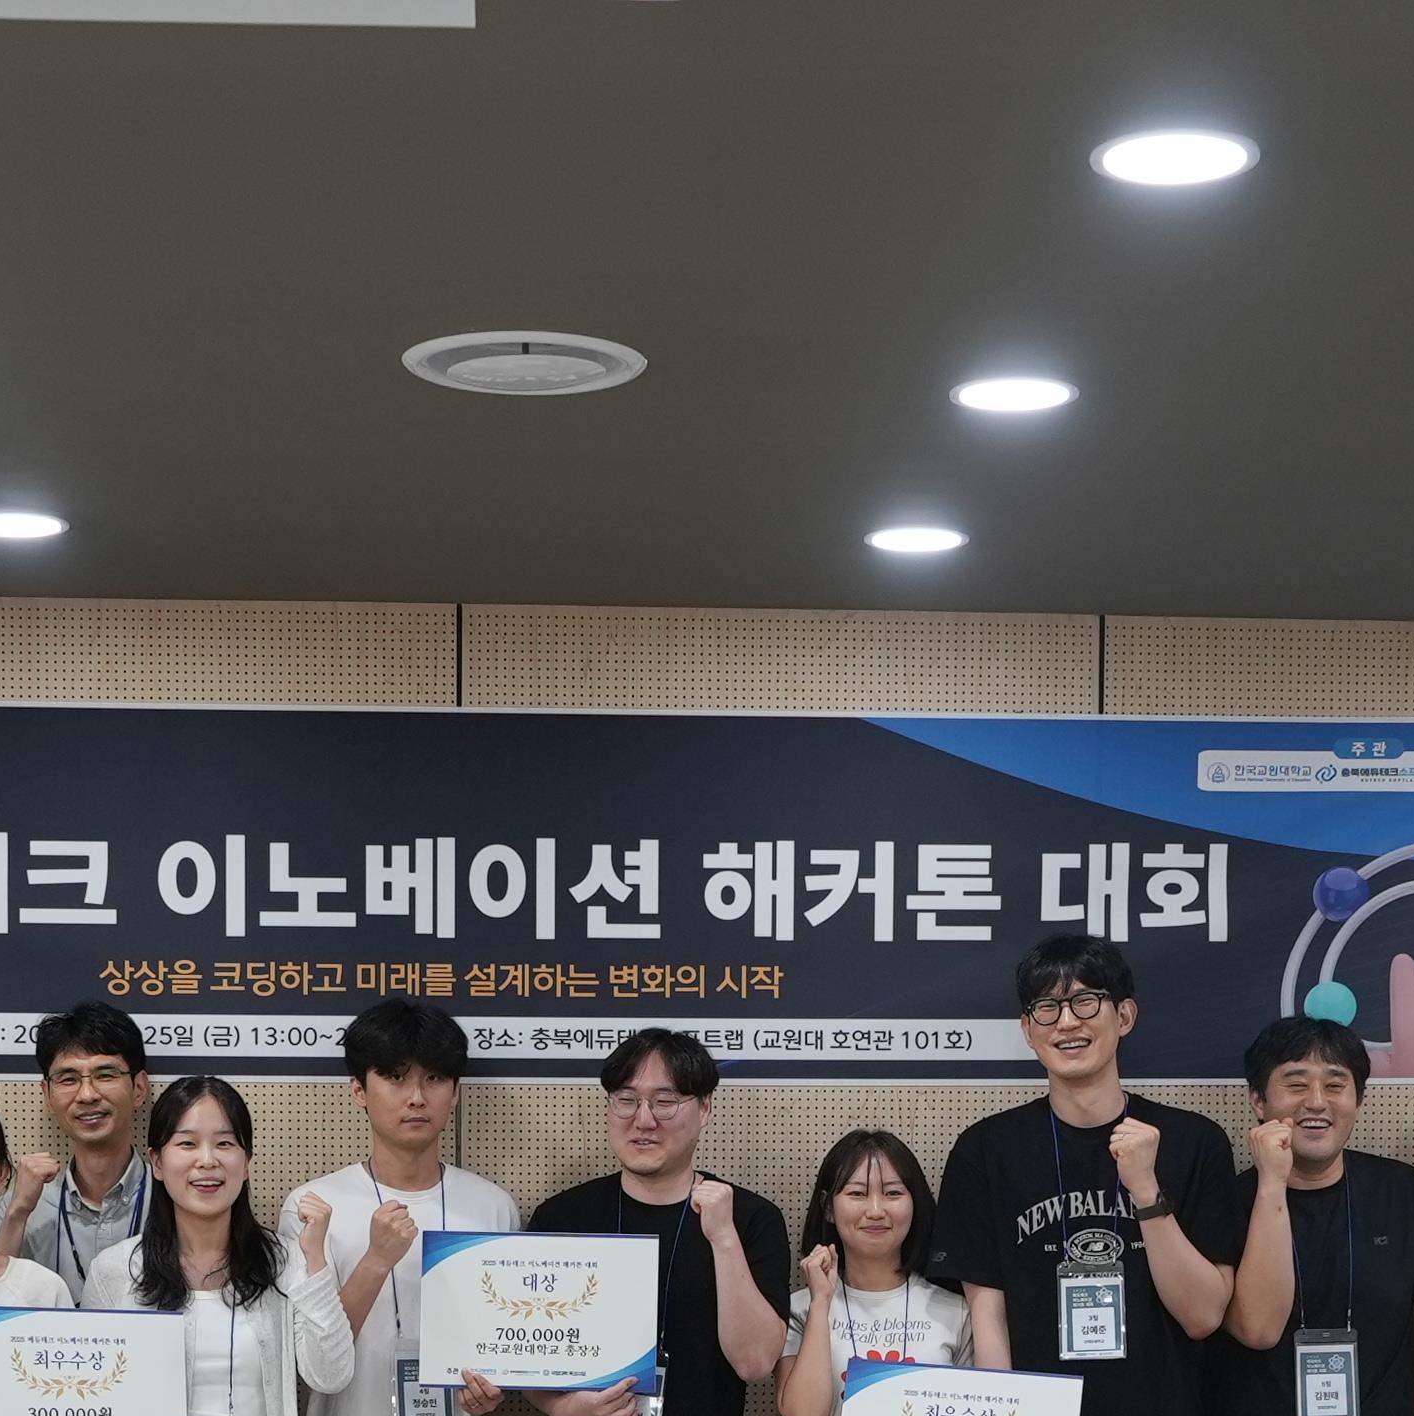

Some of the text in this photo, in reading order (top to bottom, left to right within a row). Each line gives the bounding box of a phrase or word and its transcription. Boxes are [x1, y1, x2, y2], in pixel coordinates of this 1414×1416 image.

[157, 834, 661, 940] 이노베이션
[702, 840, 1002, 943] 해커톤
[1040, 841, 1228, 943] 대회
[99, 958, 785, 999] 상상을 코딩하고 미래를 설계하는 변화의 시작
[203, 1024, 241, 1049] (금)
[251, 1026, 347, 1047] 13:00~2
[473, 1028, 524, 1051] 장소:
[753, 1030, 825, 1051] (교원대
[830, 1030, 894, 1052] 호연관
[902, 1030, 973, 1052] 101호)
[1016, 1194, 1067, 1245] NEW
[522, 1273, 560, 1293] 대상
[495, 1327, 581, 1344] 700,000원
[832, 1318, 932, 1333] bulbs & blooms
[840, 1330, 925, 1348] locally grown
[33, 1349, 106, 1371] 최우수상
